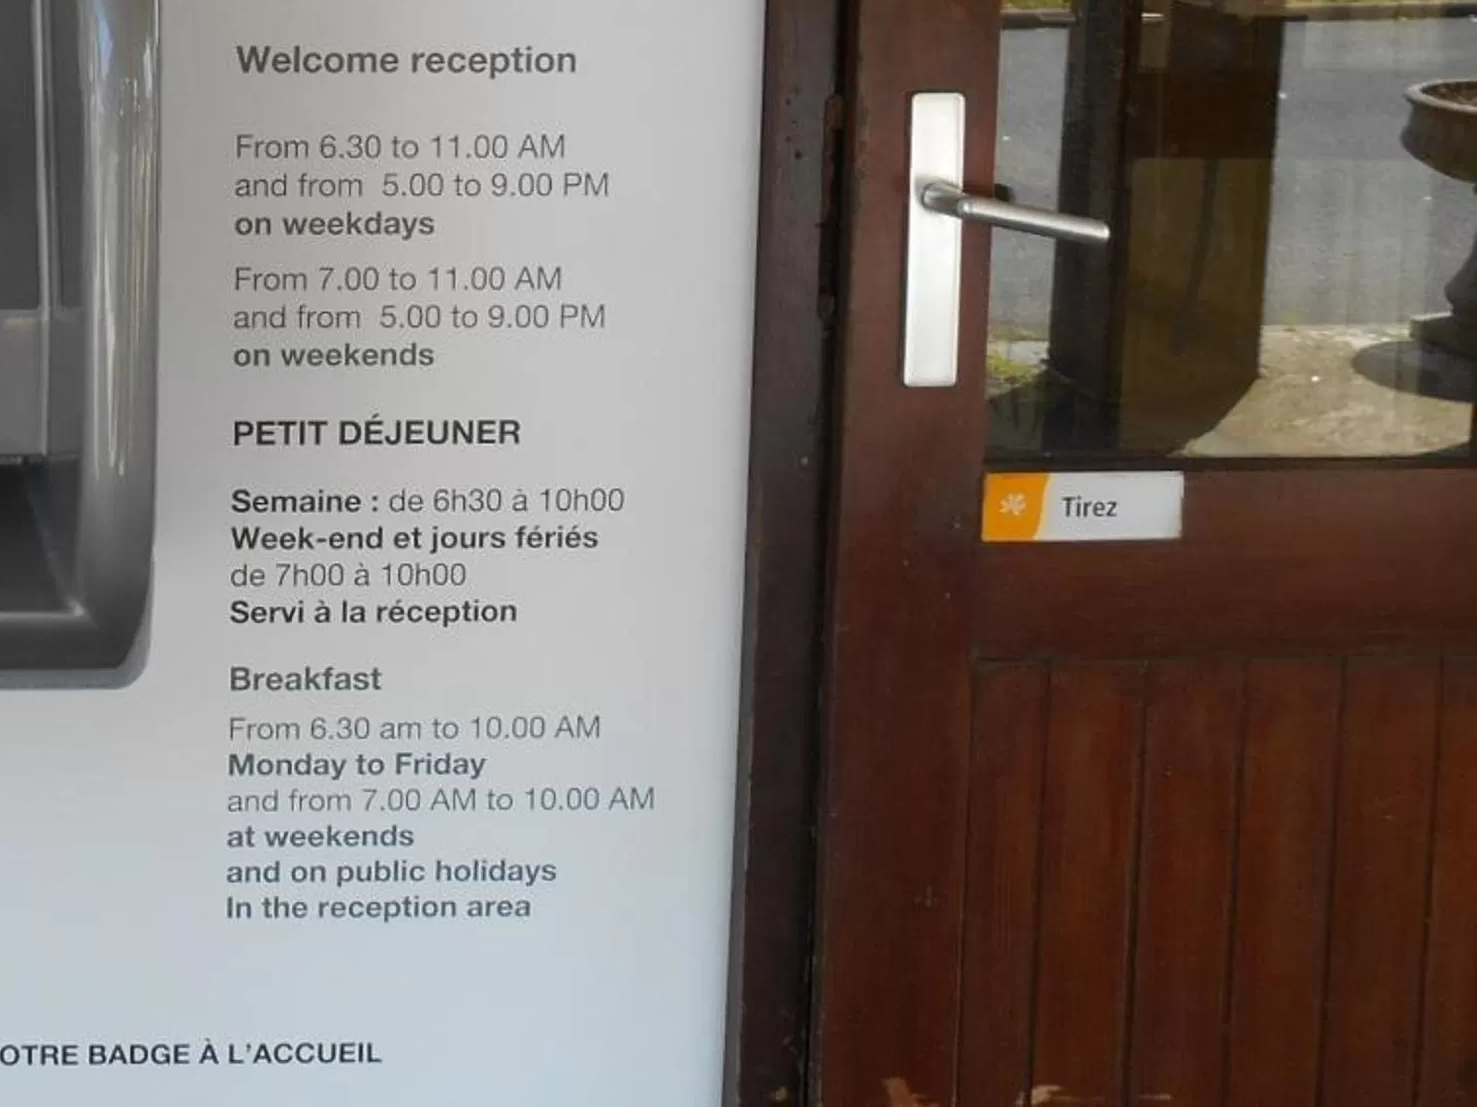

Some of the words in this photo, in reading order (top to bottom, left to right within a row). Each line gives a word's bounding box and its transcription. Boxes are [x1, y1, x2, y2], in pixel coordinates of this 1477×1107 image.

[236, 45, 399, 73] Welcome
[412, 46, 576, 79] reception
[237, 134, 309, 159] From
[320, 134, 381, 159] 6.30
[392, 136, 419, 159] to
[432, 135, 508, 159] 11.00
[517, 134, 564, 159] AM
[235, 172, 287, 197] and
[298, 172, 363, 197] from
[382, 173, 444, 197] 5.00
[452, 173, 481, 197] to
[491, 172, 552, 197] 9.00
[564, 172, 609, 196] PM
[235, 217, 271, 235] on
[283, 211, 434, 240] weekdays
[235, 267, 307, 292] From
[319, 266, 380, 291] 7.00
[389, 268, 416, 291] to
[429, 266, 505, 291] 11.00
[514, 266, 561, 291] AM
[234, 304, 286, 329] and
[296, 304, 360, 329] from
[380, 304, 441, 328] 5.00
[450, 305, 478, 328] to
[488, 304, 549, 328] 9.00
[560, 303, 604, 328] PM
[234, 349, 270, 367] on
[281, 342, 434, 366] weekends
[234, 421, 328, 445] PETIT
[340, 413, 520, 445] DÉJEUNER
[232, 489, 361, 513] Semaine
[389, 489, 424, 513] de
[434, 488, 502, 512] 6h30
[512, 489, 528, 512] à
[540, 488, 624, 513] 10h00
[1062, 496, 1118, 517] Tirez
[231, 526, 383, 550] Week-end
[394, 527, 422, 549] et
[430, 526, 505, 554] jours
[515, 525, 598, 548] fériés
[231, 563, 265, 587] de
[276, 563, 344, 587] 7h00
[354, 562, 370, 586] à
[382, 563, 466, 586] 10h00
[230, 600, 304, 623] Servi
[314, 600, 331, 623] à
[342, 600, 365, 623] la
[377, 599, 516, 627] réception
[231, 666, 381, 691] Breakfast
[230, 717, 300, 741] From
[310, 717, 370, 740] 6.30
[380, 722, 421, 740] am
[432, 719, 459, 739] to
[471, 716, 545, 739] 10.00
[554, 715, 600, 738] AM
[229, 753, 347, 780] Monday
[356, 754, 385, 776] to
[396, 752, 486, 780] Friday
[228, 789, 278, 812] and
[288, 788, 351, 812] from
[362, 788, 421, 812] 7.00
[430, 788, 476, 811] AM
[487, 789, 513, 811] to
[525, 787, 600, 810] 10.00
[608, 786, 654, 810] AM
[227, 826, 255, 847] at
[264, 825, 414, 847] weekends
[227, 860, 280, 883] and
[291, 866, 326, 883] on
[337, 860, 424, 887] public
[436, 860, 556, 887] holidays
[227, 897, 251, 918] In
[262, 896, 308, 918] the
[319, 895, 456, 922] reception
[467, 900, 530, 917] area
[89, 1044, 189, 1065] BADGE
[199, 1038, 219, 1064] À
[229, 1043, 382, 1064] L'ACCUEIL
